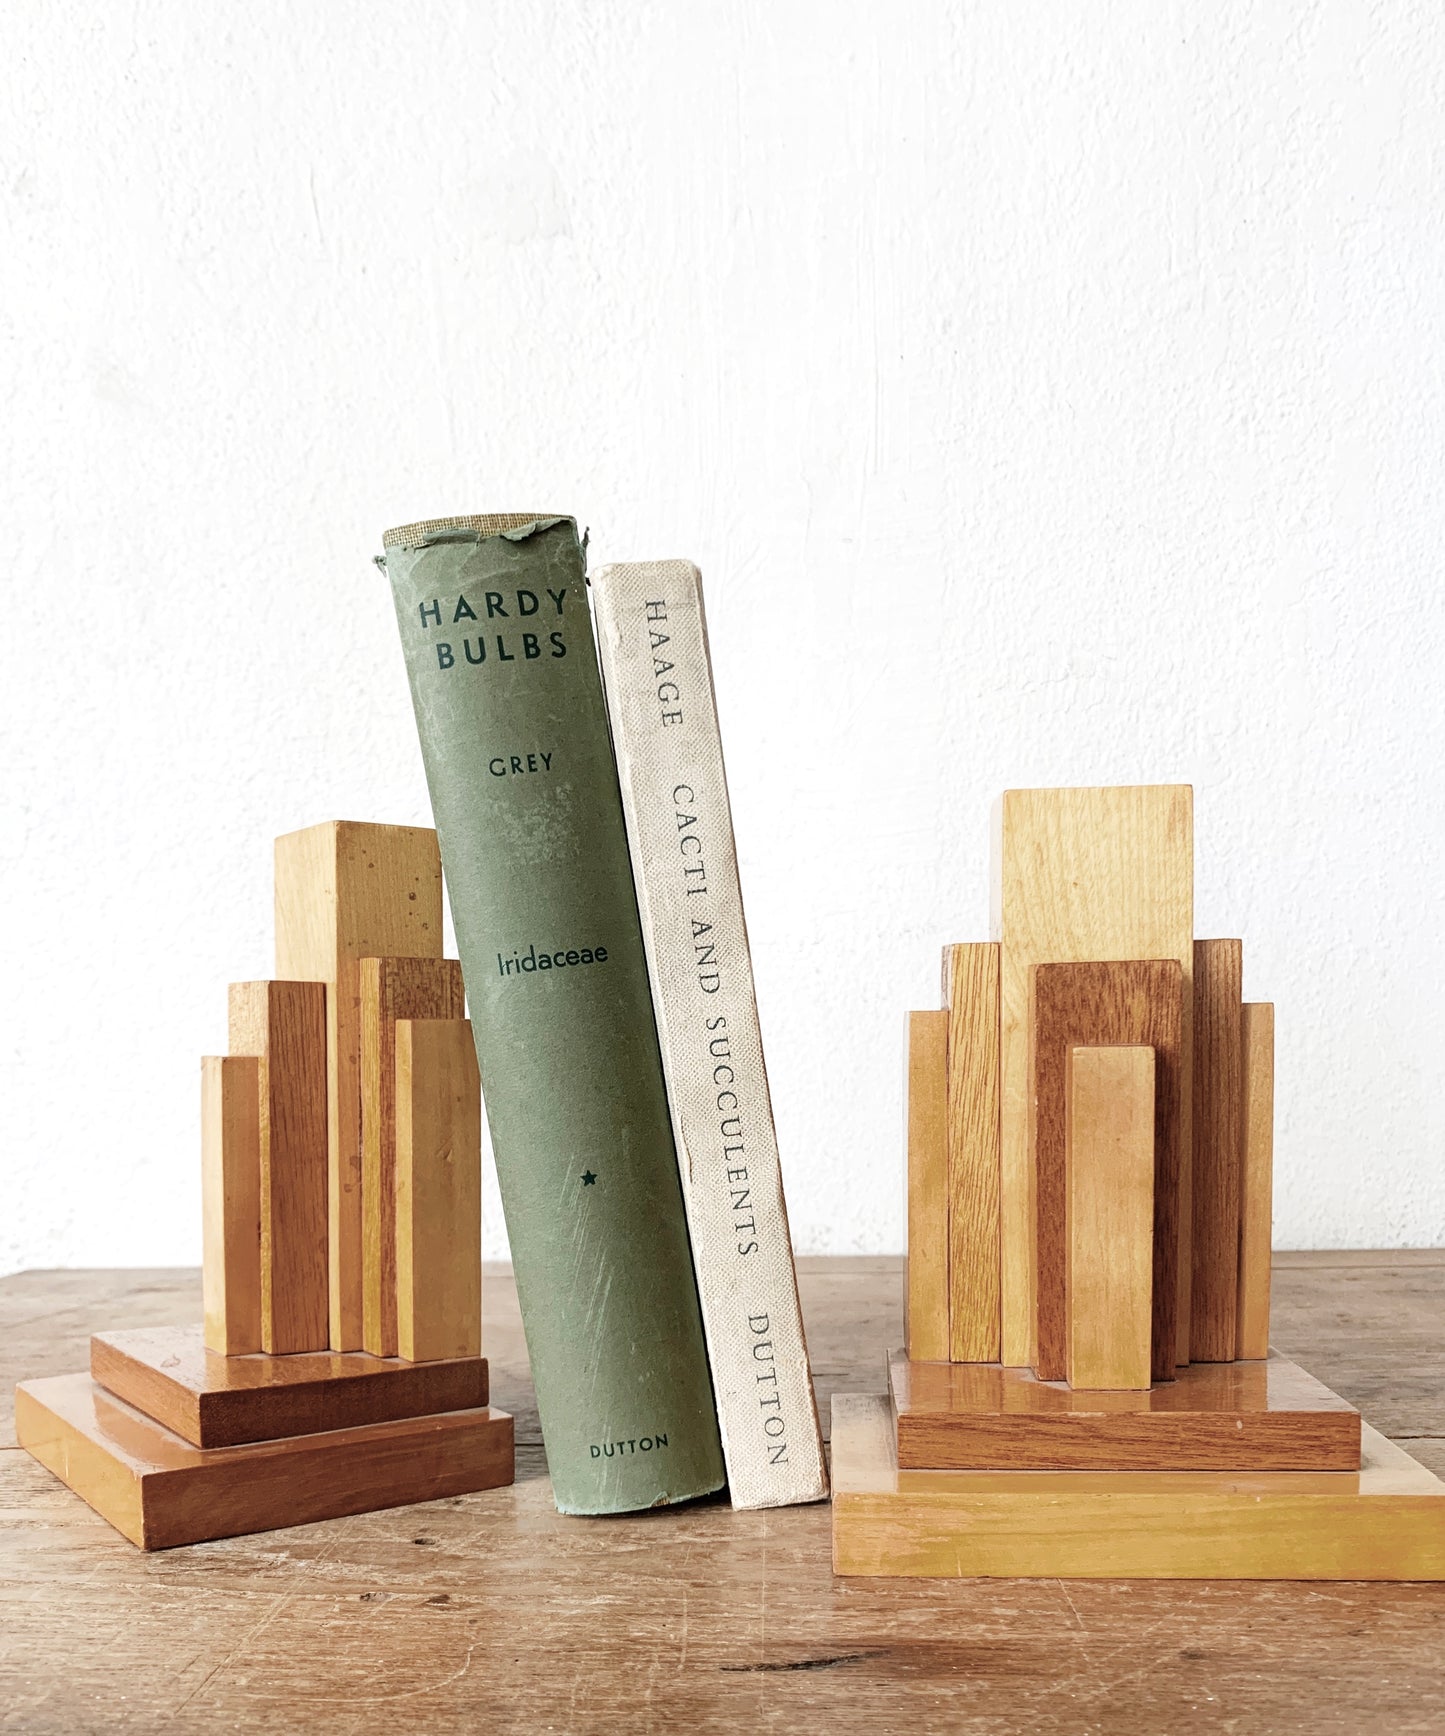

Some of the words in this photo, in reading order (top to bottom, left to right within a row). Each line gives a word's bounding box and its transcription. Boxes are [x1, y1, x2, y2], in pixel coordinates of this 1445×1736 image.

[419, 588, 567, 629] HARDY
[437, 631, 567, 670] BULBS
[645, 599, 684, 728] HAAGE
[488, 753, 553, 777] GREY
[673, 784, 708, 897] CACTI
[498, 945, 608, 976] Iridaceae
[691, 919, 721, 995] AND
[705, 1016, 759, 1258] SUCCULENTS
[748, 1314, 790, 1467] DUTTON
[590, 1433, 669, 1459] DUTTON
